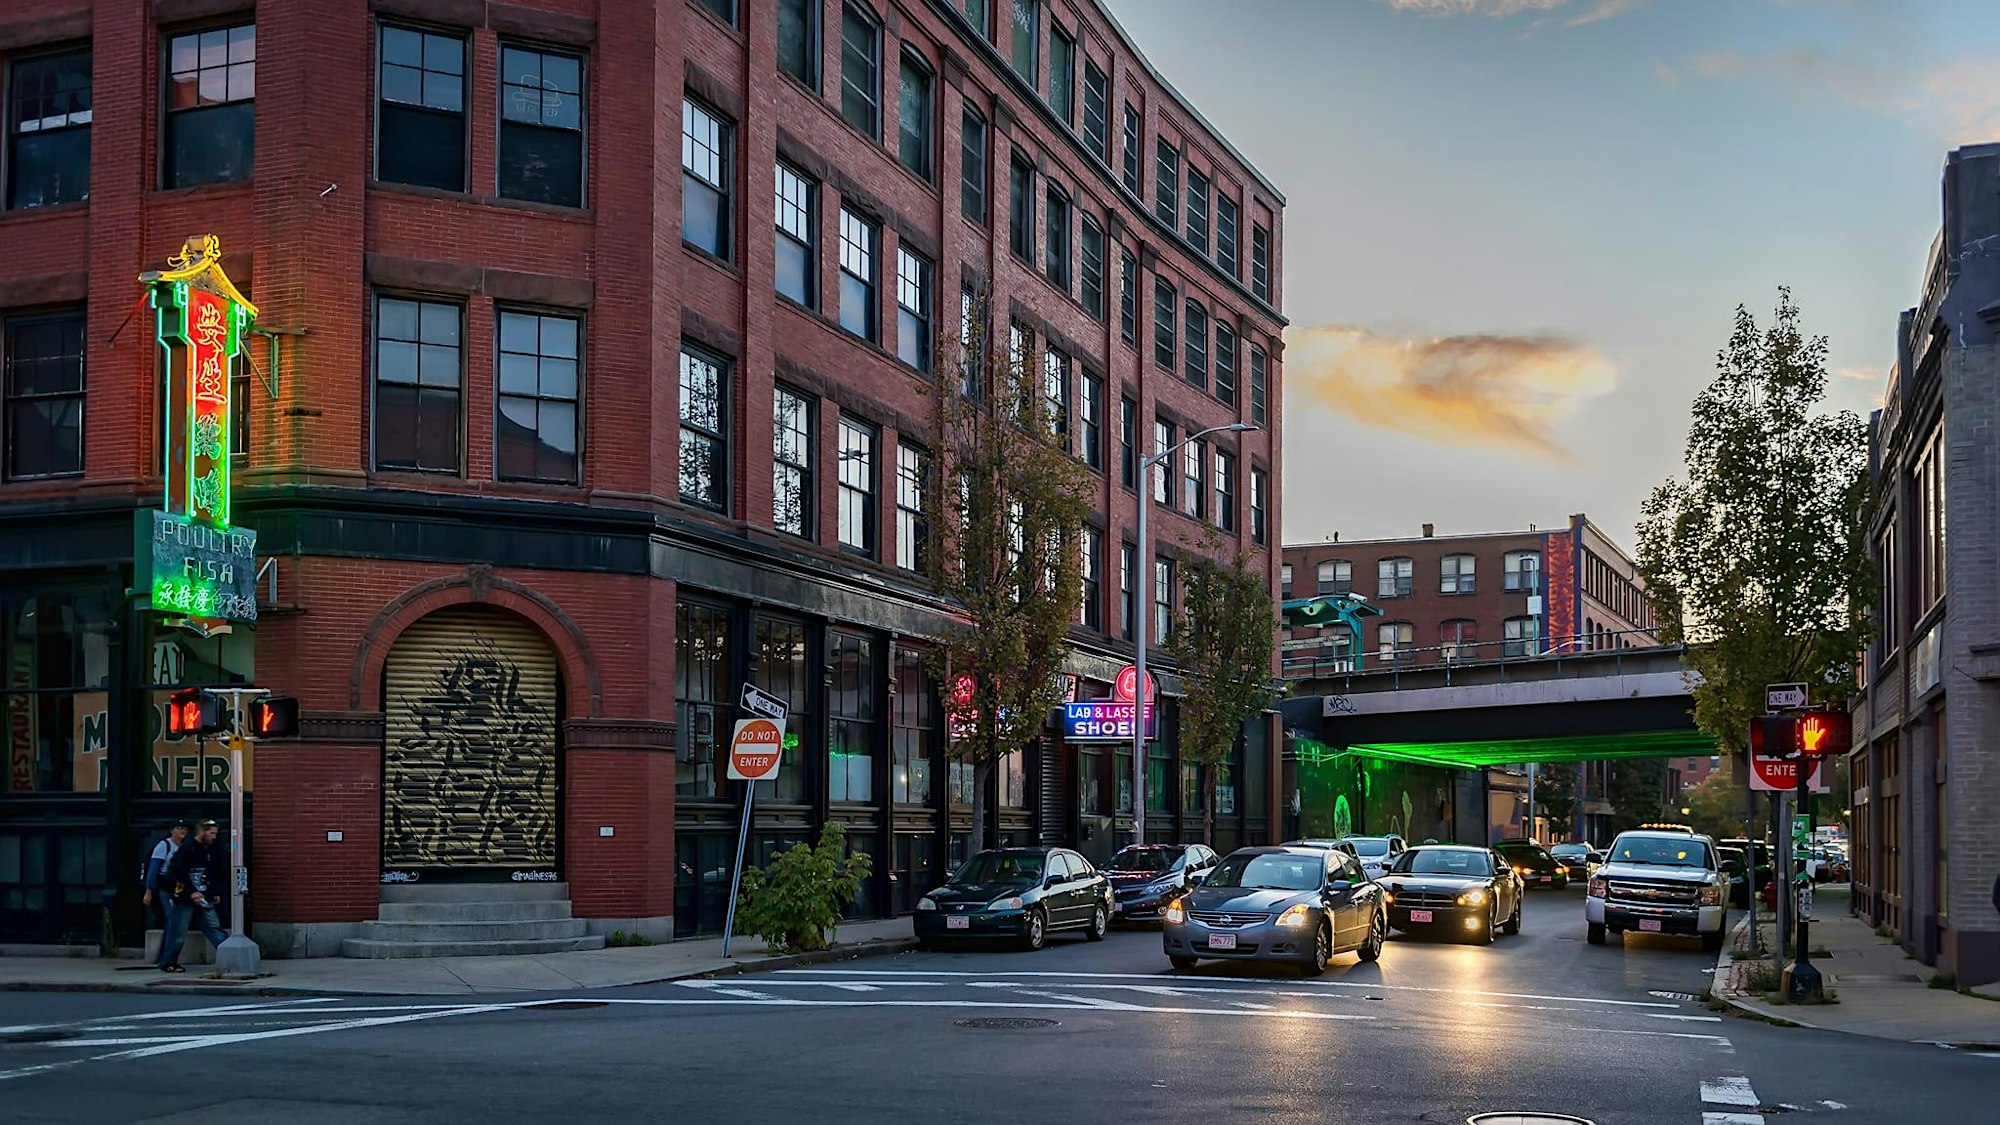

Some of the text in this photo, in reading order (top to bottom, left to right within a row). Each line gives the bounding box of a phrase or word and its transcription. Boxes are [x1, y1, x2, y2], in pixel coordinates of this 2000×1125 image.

[158, 519, 257, 559] POULTRY
[769, 704, 784, 718] WAY
[1068, 705, 1150, 718] LAB & LASSE
[741, 730, 778, 741] DO NOT
[739, 757, 769, 767] ENTER
[1765, 764, 1797, 776] ENTE
